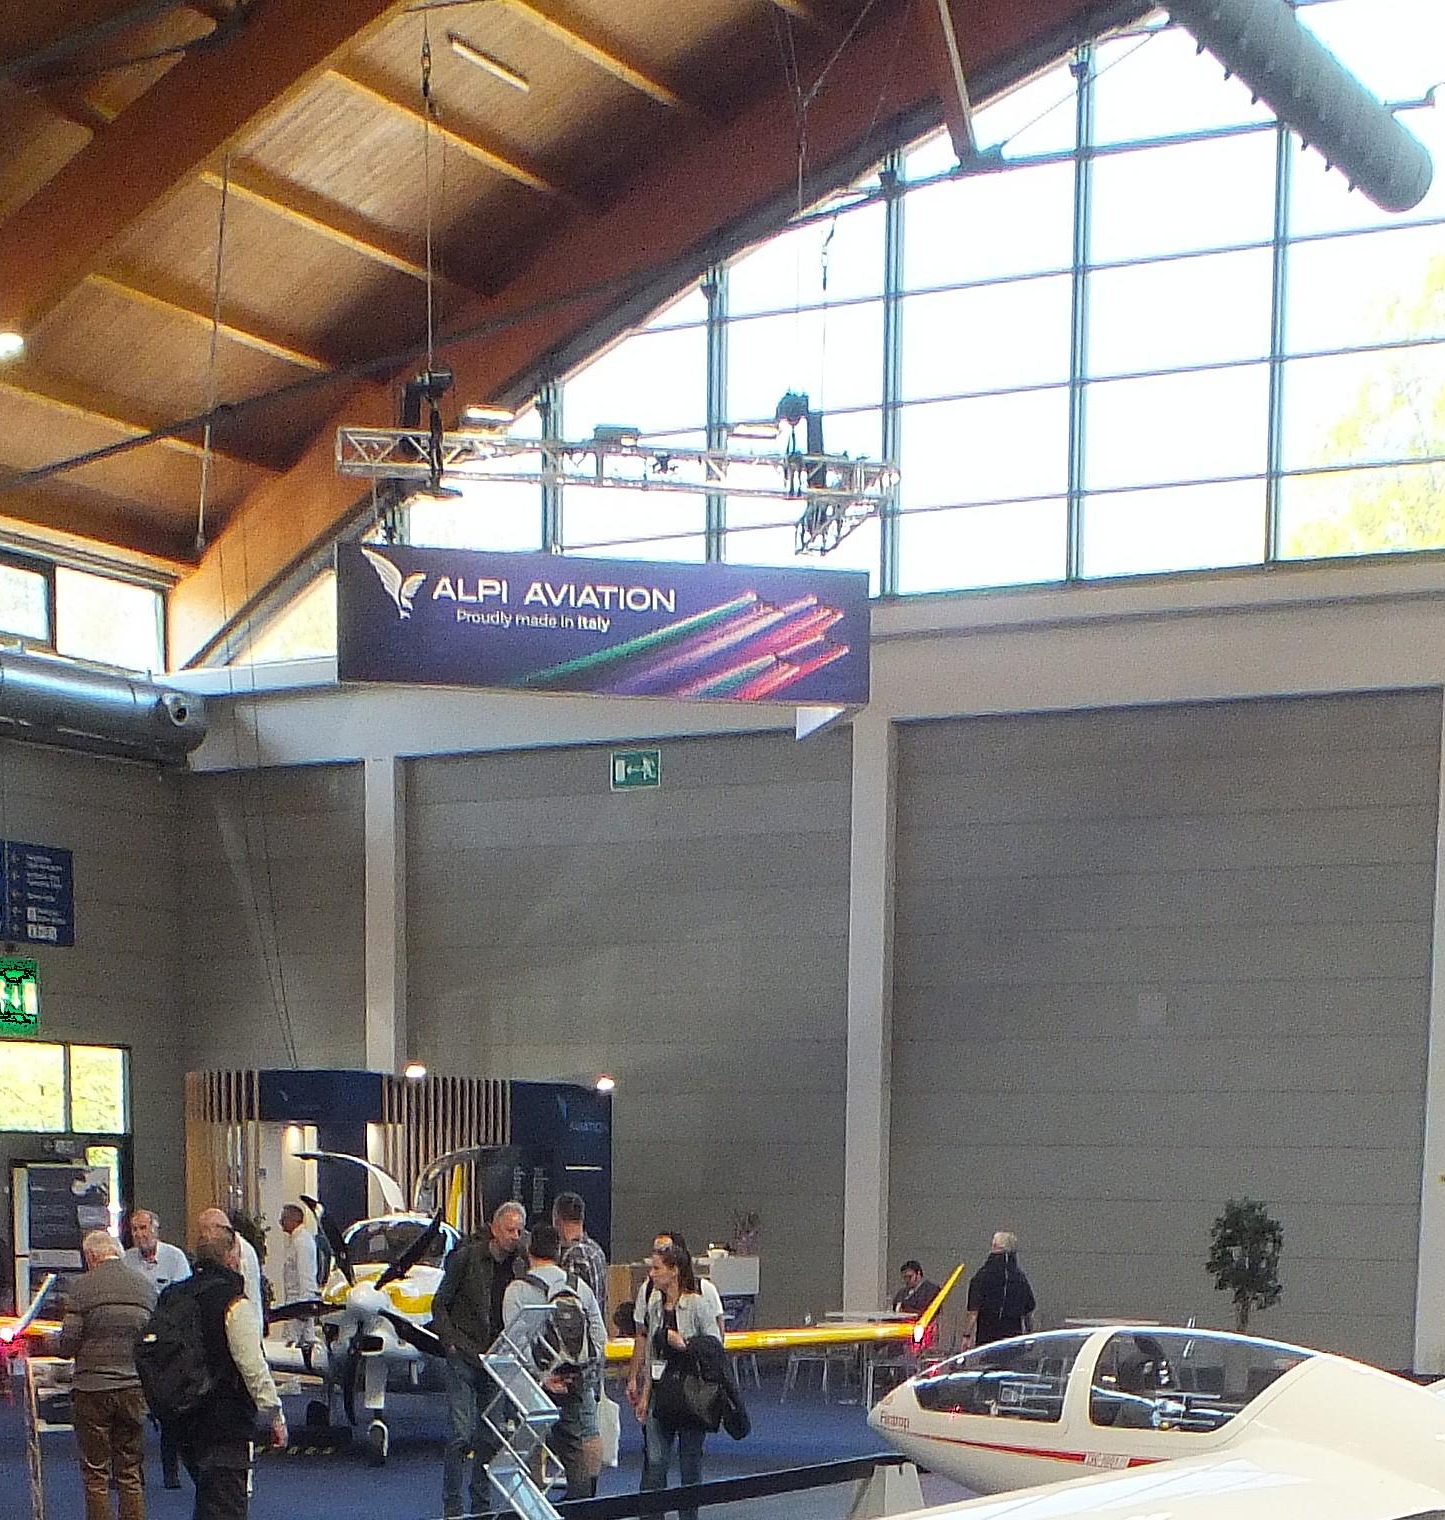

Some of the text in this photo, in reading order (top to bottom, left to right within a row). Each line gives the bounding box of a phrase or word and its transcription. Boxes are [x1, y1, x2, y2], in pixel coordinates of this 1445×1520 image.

[432, 575, 676, 613] ALPI AVIATION
[456, 608, 611, 633] Proudly made in Italy
